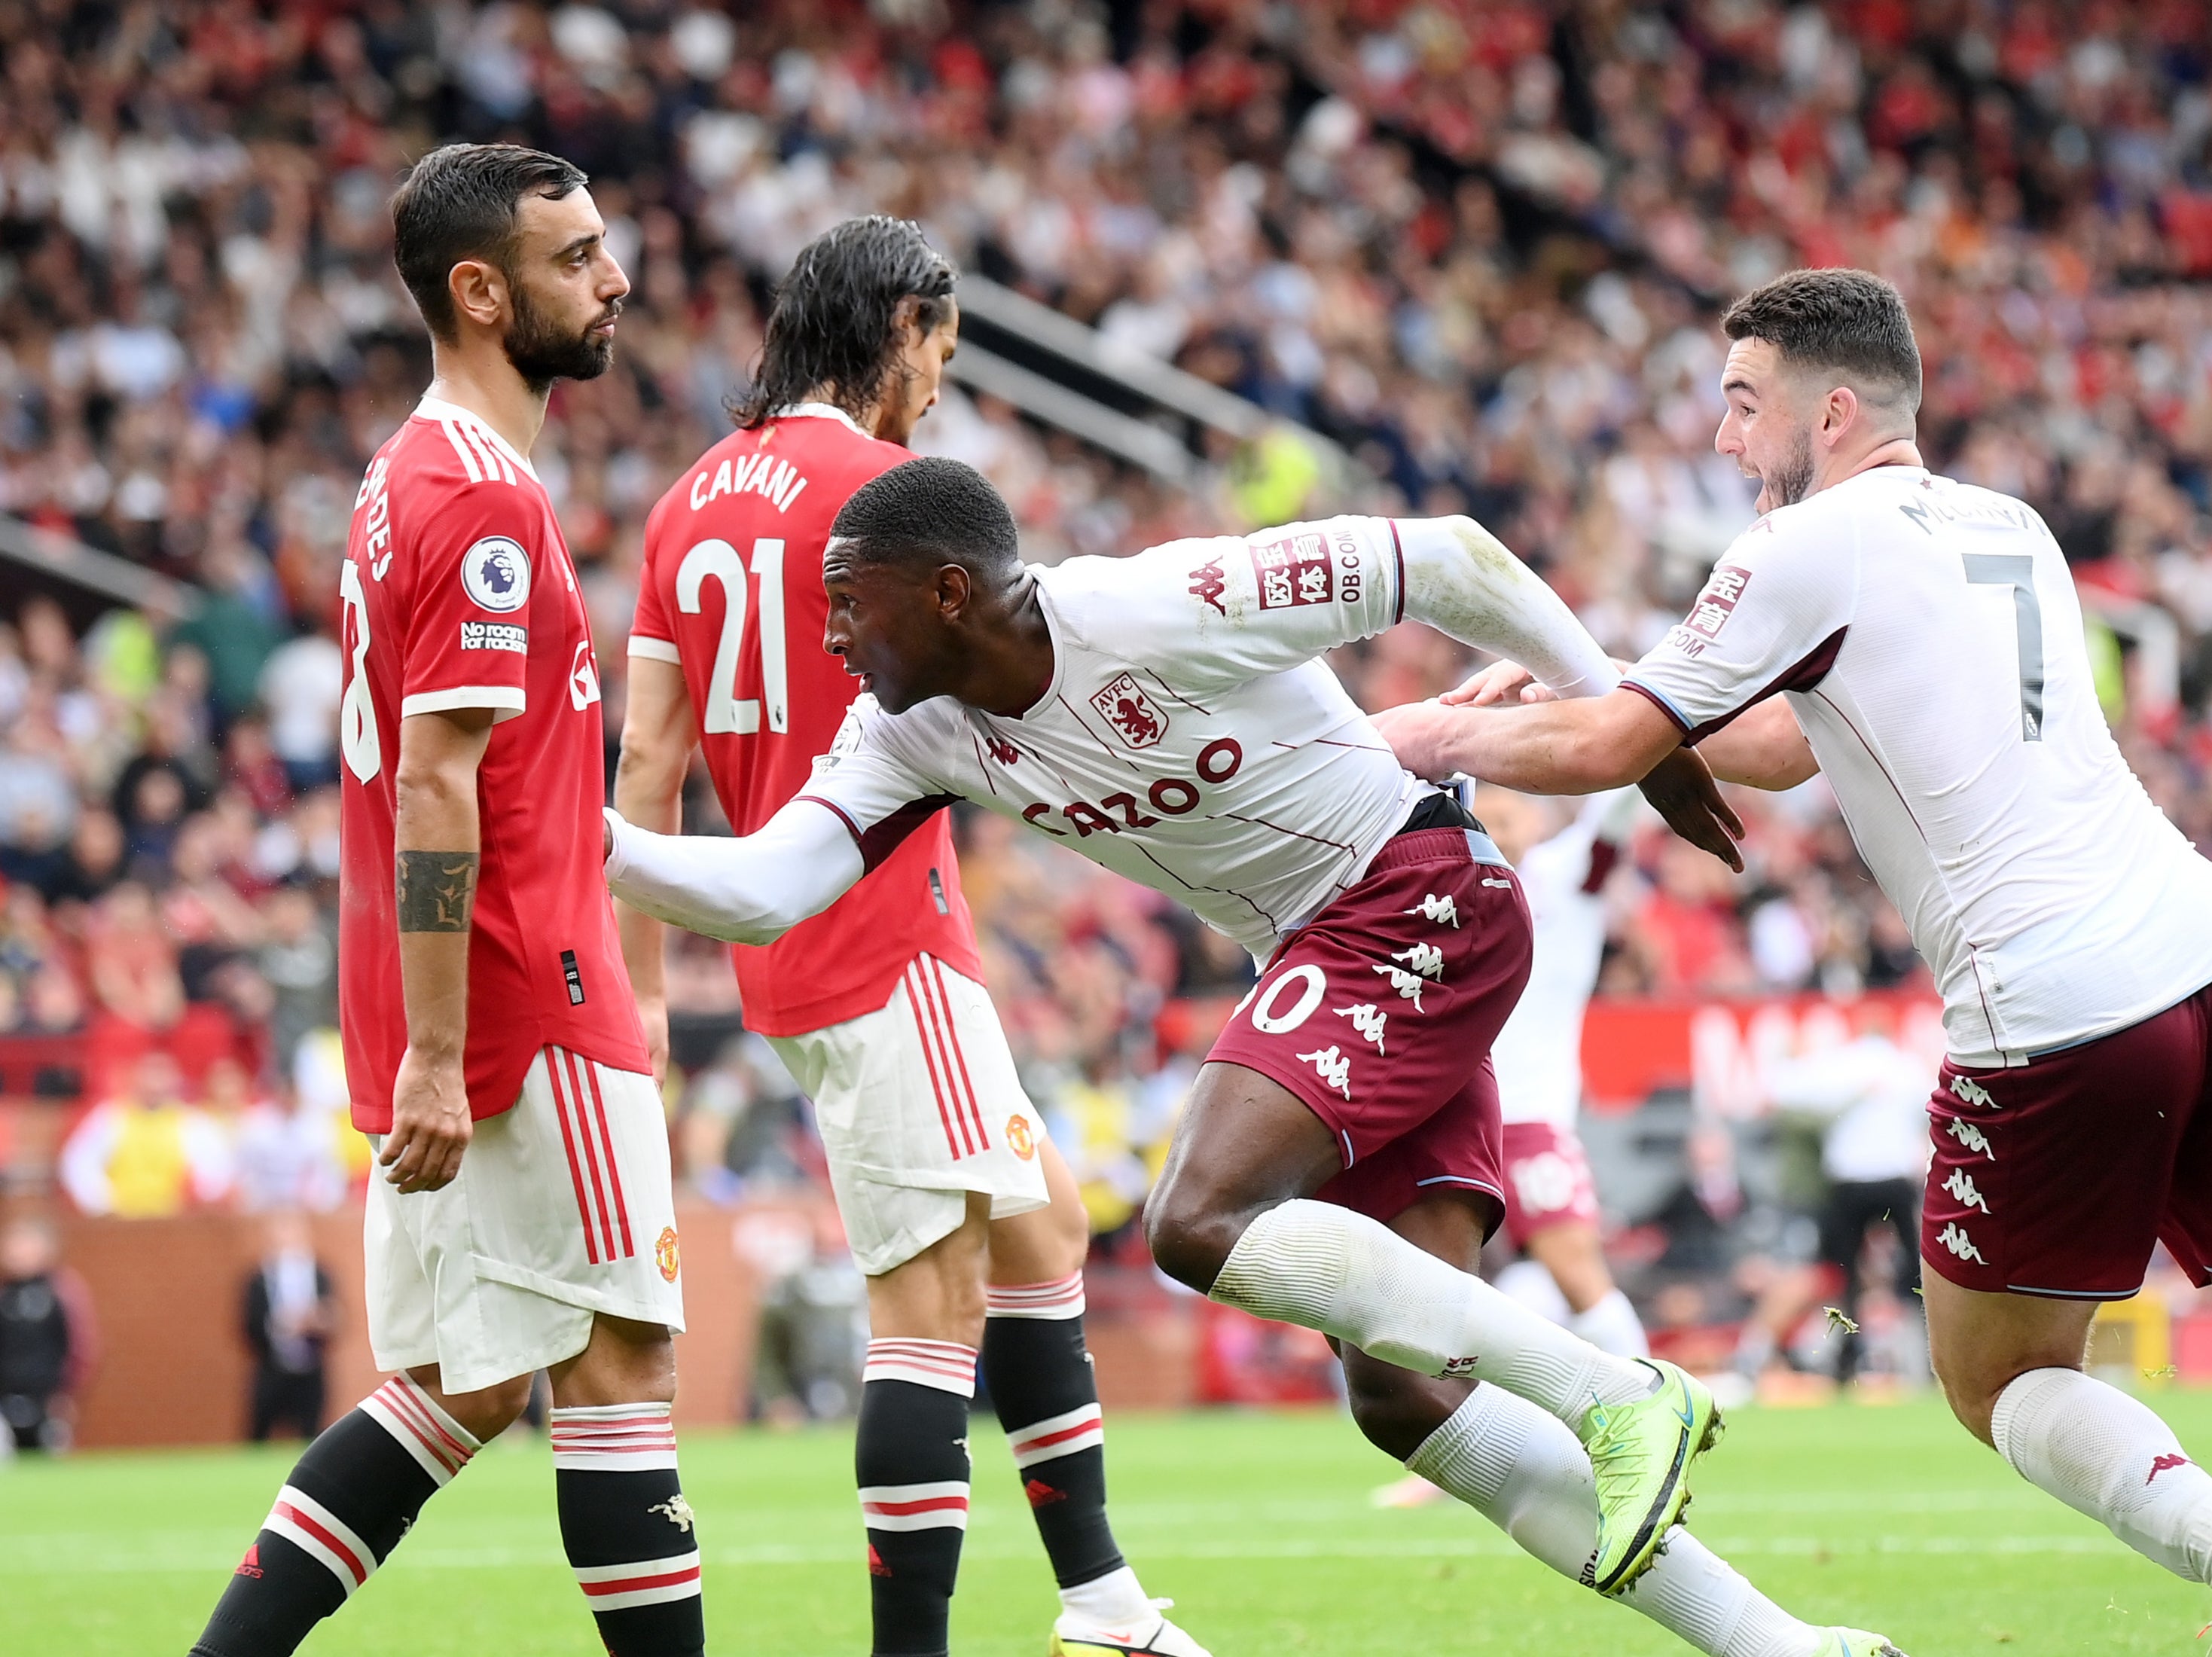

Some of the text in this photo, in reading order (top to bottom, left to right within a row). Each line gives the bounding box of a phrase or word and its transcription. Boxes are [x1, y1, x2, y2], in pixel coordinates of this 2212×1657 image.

[690, 453, 808, 513] CAVANI
[461, 622, 526, 642] No room
[461, 635, 484, 650] for
[676, 538, 789, 734] 21
[1960, 553, 2045, 742] 7
[1098, 677, 1133, 711] AVFC
